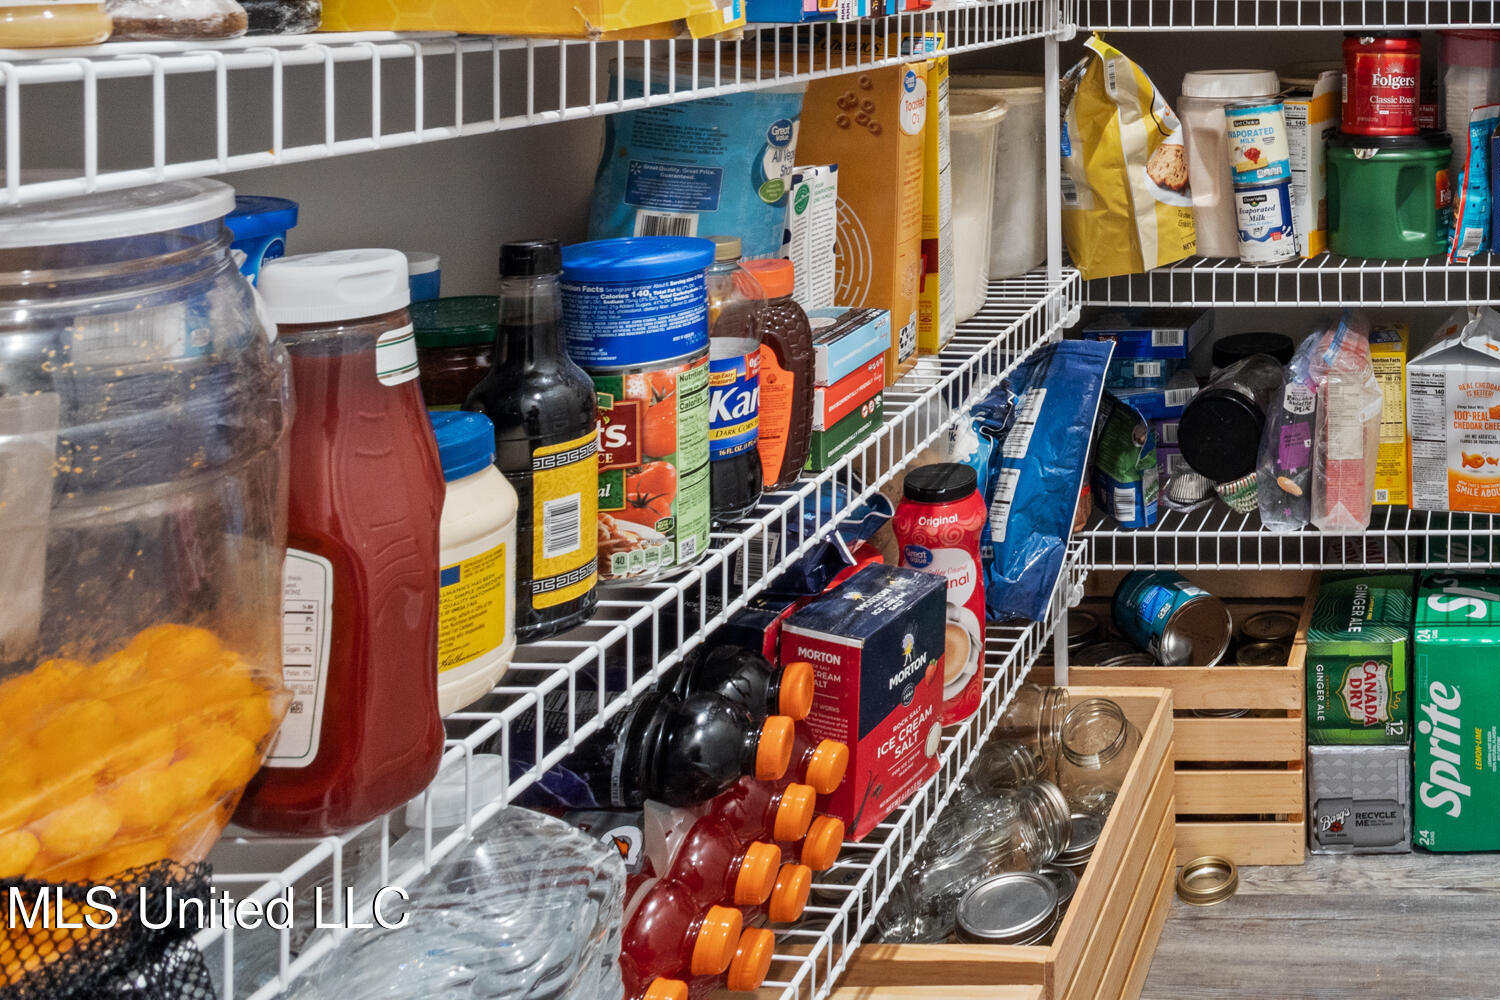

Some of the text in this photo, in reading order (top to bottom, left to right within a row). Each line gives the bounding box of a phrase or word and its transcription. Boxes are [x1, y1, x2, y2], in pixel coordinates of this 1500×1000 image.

[1371, 73, 1415, 90] Folgers
[905, 97, 925, 113] Toasted
[1369, 95, 1398, 104] Classic
[771, 125, 791, 136] Great
[771, 150, 783, 163] All
[660, 172, 696, 180] Guaranteed.
[1239, 204, 1276, 216] Evaporated
[1248, 214, 1266, 223] Milk
[631, 290, 653, 298] 140,
[1472, 411, 1489, 421] REAL
[715, 427, 736, 439] DARK
[1454, 422, 1483, 430] CHEDDAR
[1456, 485, 1479, 496] SMILE
[917, 513, 959, 529] Original
[615, 555, 625, 565] 40
[905, 548, 928, 560] Great
[1348, 583, 1368, 633] GINGER ALE
[1416, 628, 1431, 641] 24
[797, 646, 841, 666] MORTON
[888, 651, 928, 691] MORTON
[1316, 664, 1325, 721] GINGER ALE
[1349, 677, 1362, 711] DRY
[1362, 660, 1379, 727] CANADA
[892, 704, 922, 732] ROCK SALT
[876, 704, 933, 759] ICE CREAM
[1390, 719, 1404, 736] 12
[893, 734, 920, 760] SALT
[1419, 680, 1472, 819] Sprite
[1474, 727, 1482, 771] LEMON-LIME
[1319, 806, 1351, 833] Barq's
[1355, 811, 1397, 820] RECYCLE
[1355, 819, 1370, 827] ME
[1419, 829, 1430, 846] 24
